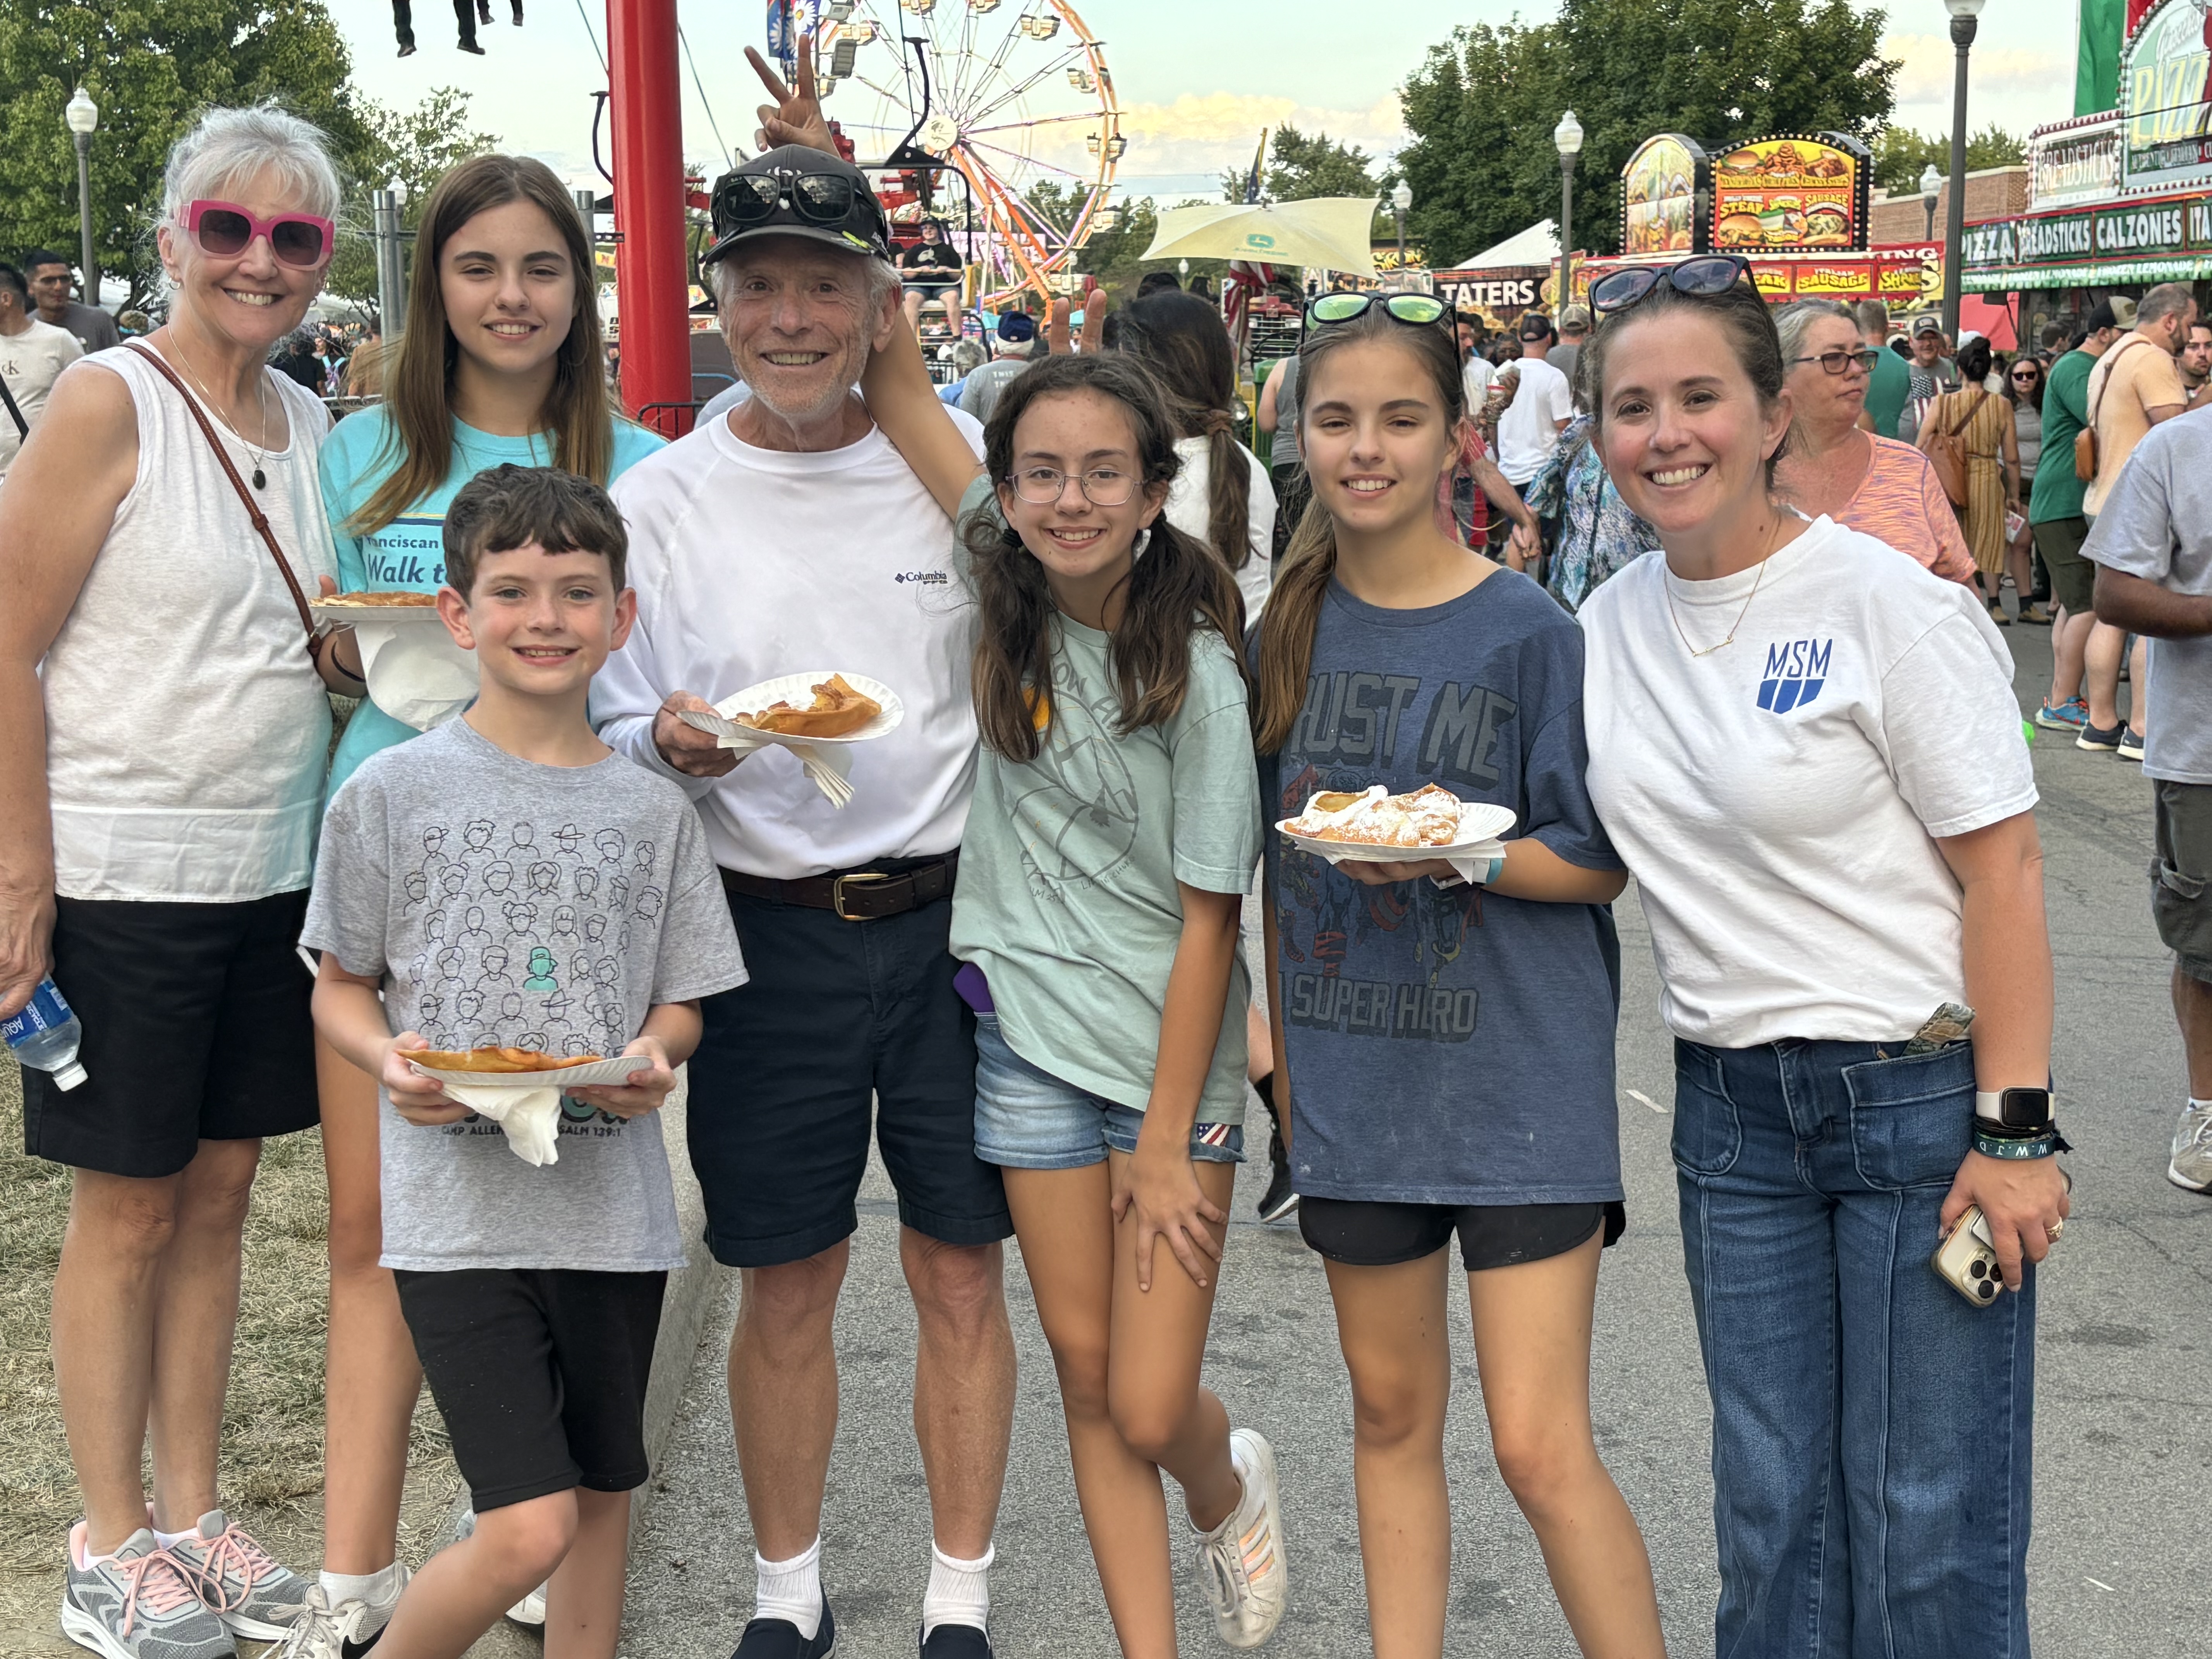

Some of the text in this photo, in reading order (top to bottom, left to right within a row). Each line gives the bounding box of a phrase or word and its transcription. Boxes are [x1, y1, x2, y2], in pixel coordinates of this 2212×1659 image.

[2130, 50, 2212, 150] PIZZ
[2018, 221, 2090, 258] BREADSTICKS
[2096, 210, 2181, 250] CALZONES
[2190, 205, 2212, 242] ITA
[1754, 273, 1786, 288] EAK
[1798, 273, 1869, 289] SAUSAGE
[2136, 259, 2194, 274] LEMONADE
[1440, 279, 1535, 307] TATERS
[368, 553, 448, 584] Walk t
[906, 570, 947, 582] Columbia
[1763, 639, 1832, 679] MSM
[1417, 680, 1518, 789] ME
[1290, 972, 1479, 1043] SUPER HERO
[559, 1125, 589, 1136] SALM
